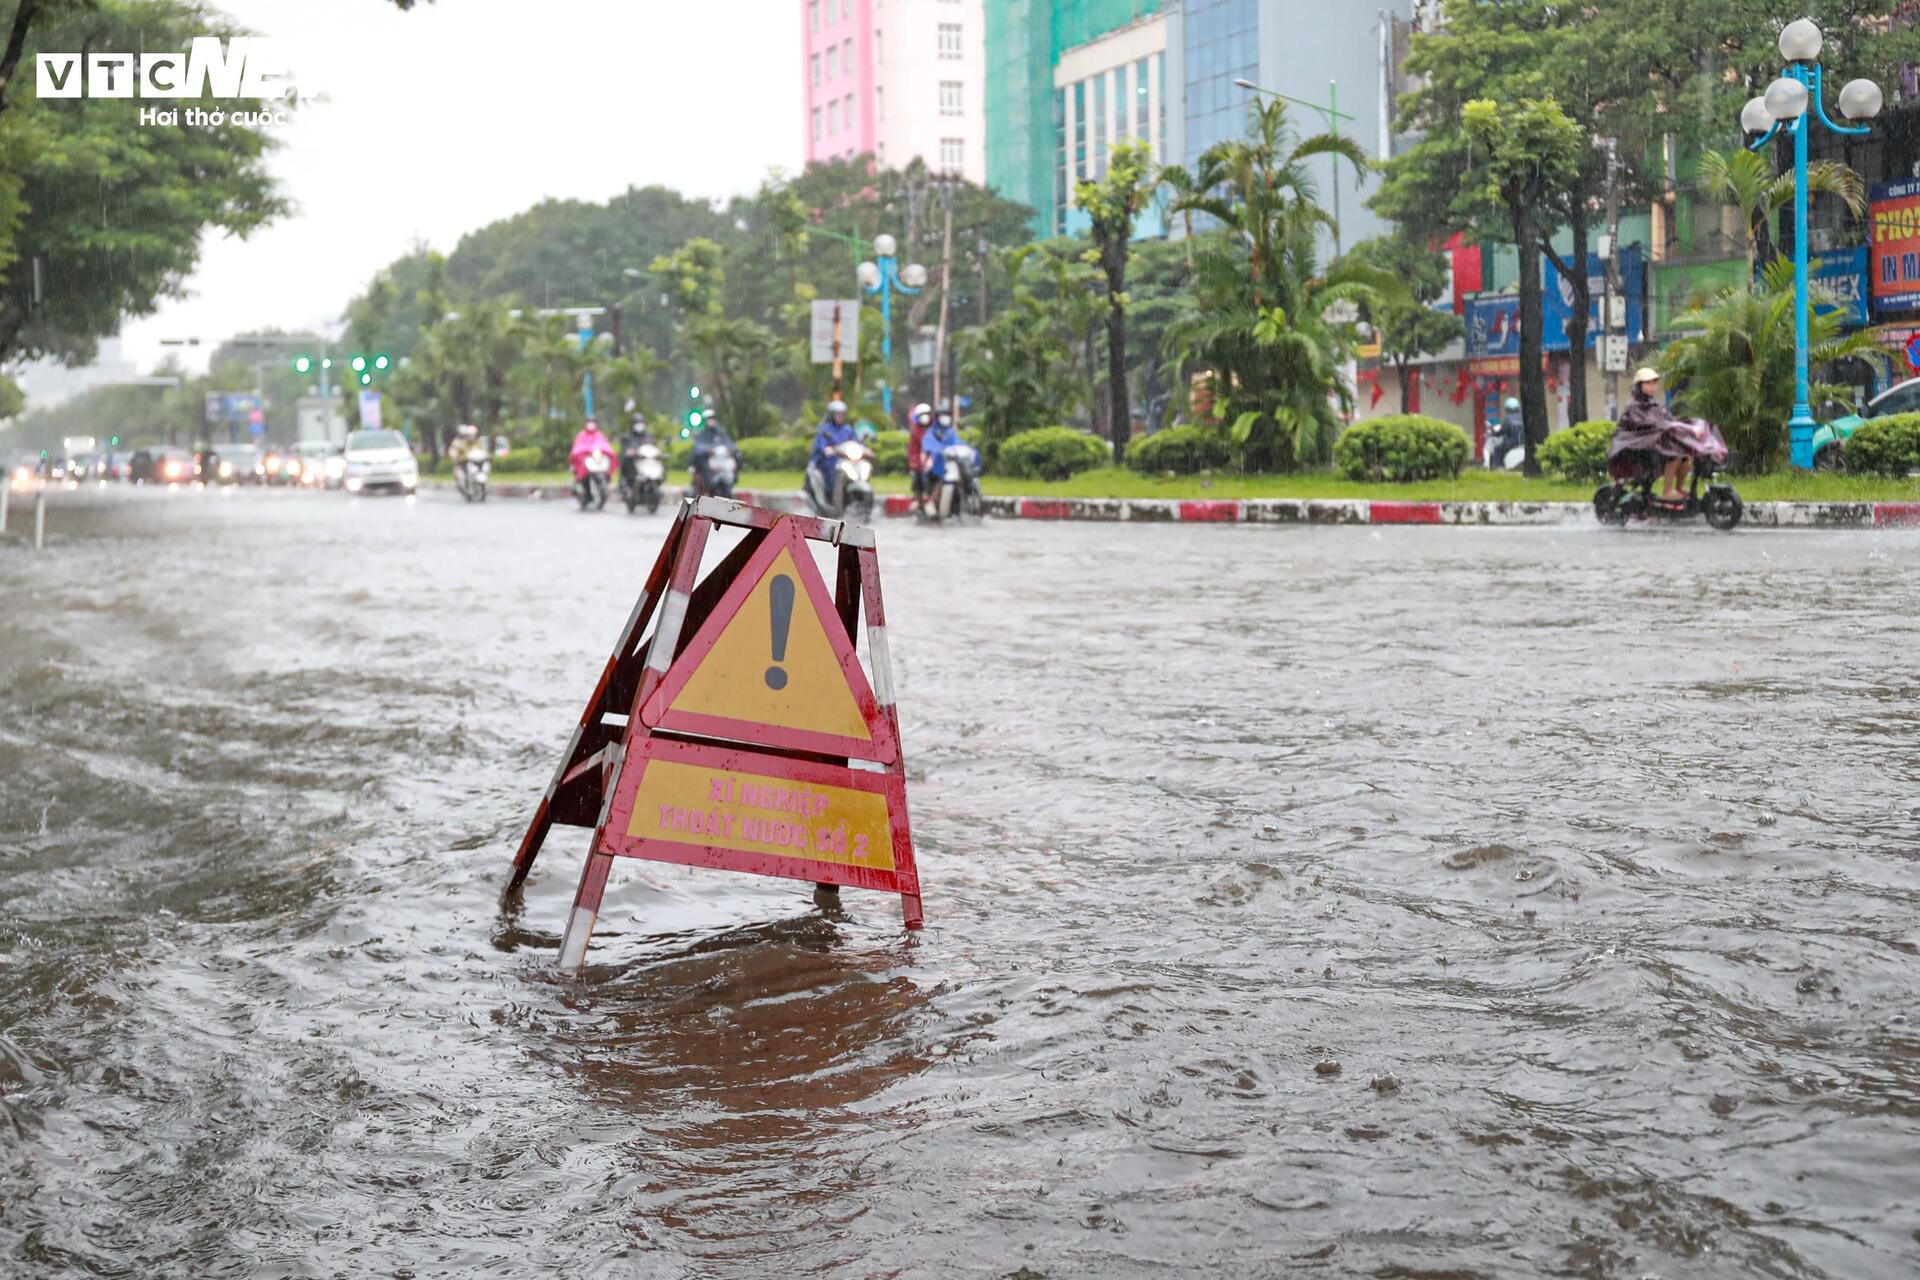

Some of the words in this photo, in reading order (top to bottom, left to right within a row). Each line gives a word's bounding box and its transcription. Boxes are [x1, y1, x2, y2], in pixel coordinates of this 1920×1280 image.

[1882, 255, 1898, 282] IN
[1902, 252, 1920, 280] M
[657, 804, 735, 838] THOÁT
[816, 818, 849, 855] SỐ
[854, 833, 869, 857] 2
